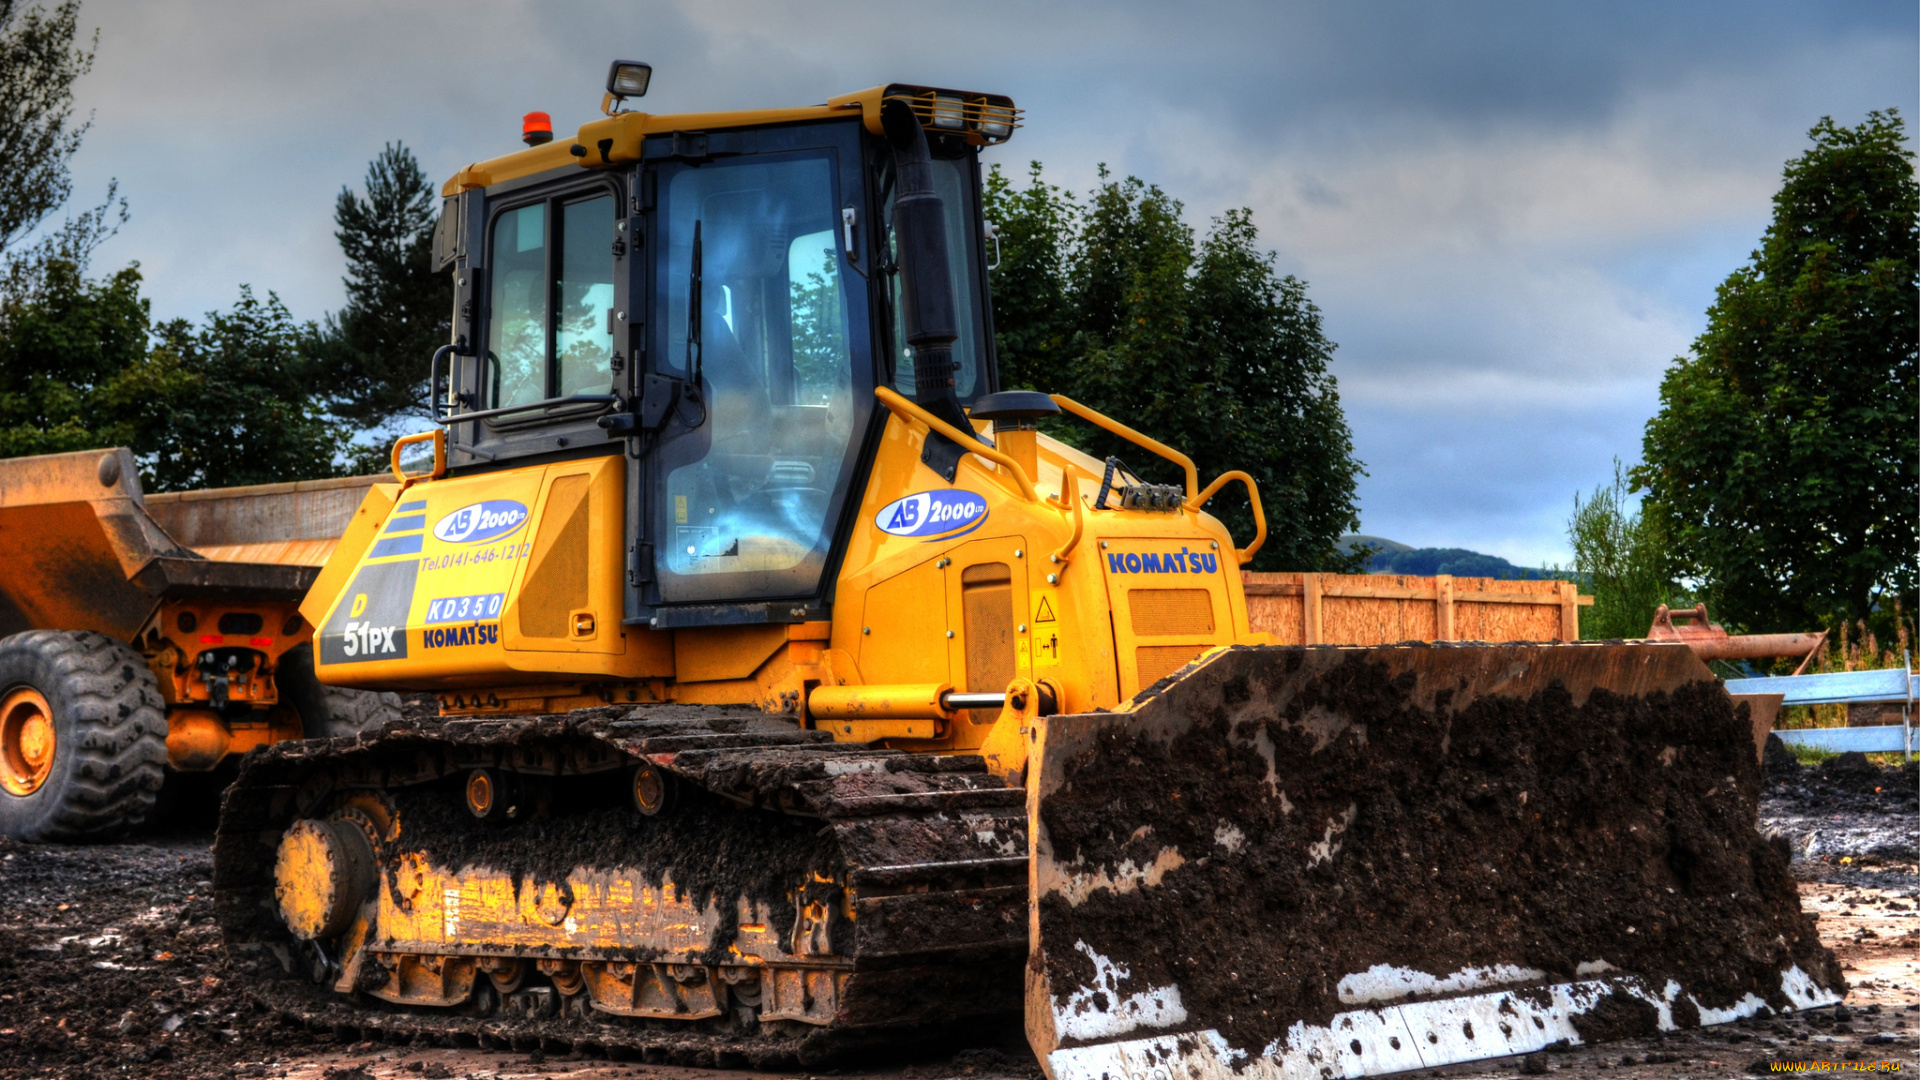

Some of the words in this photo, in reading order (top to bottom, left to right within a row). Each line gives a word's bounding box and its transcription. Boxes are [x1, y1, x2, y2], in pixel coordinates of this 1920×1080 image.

[443, 509, 472, 537] AB
[477, 509, 519, 530] 2000
[886, 498, 920, 529] AB
[929, 500, 975, 523] 2000
[1107, 546, 1218, 574] KOMATSU
[349, 593, 368, 618] D
[343, 620, 396, 657] 51PX
[423, 620, 498, 649] KOMATSU
